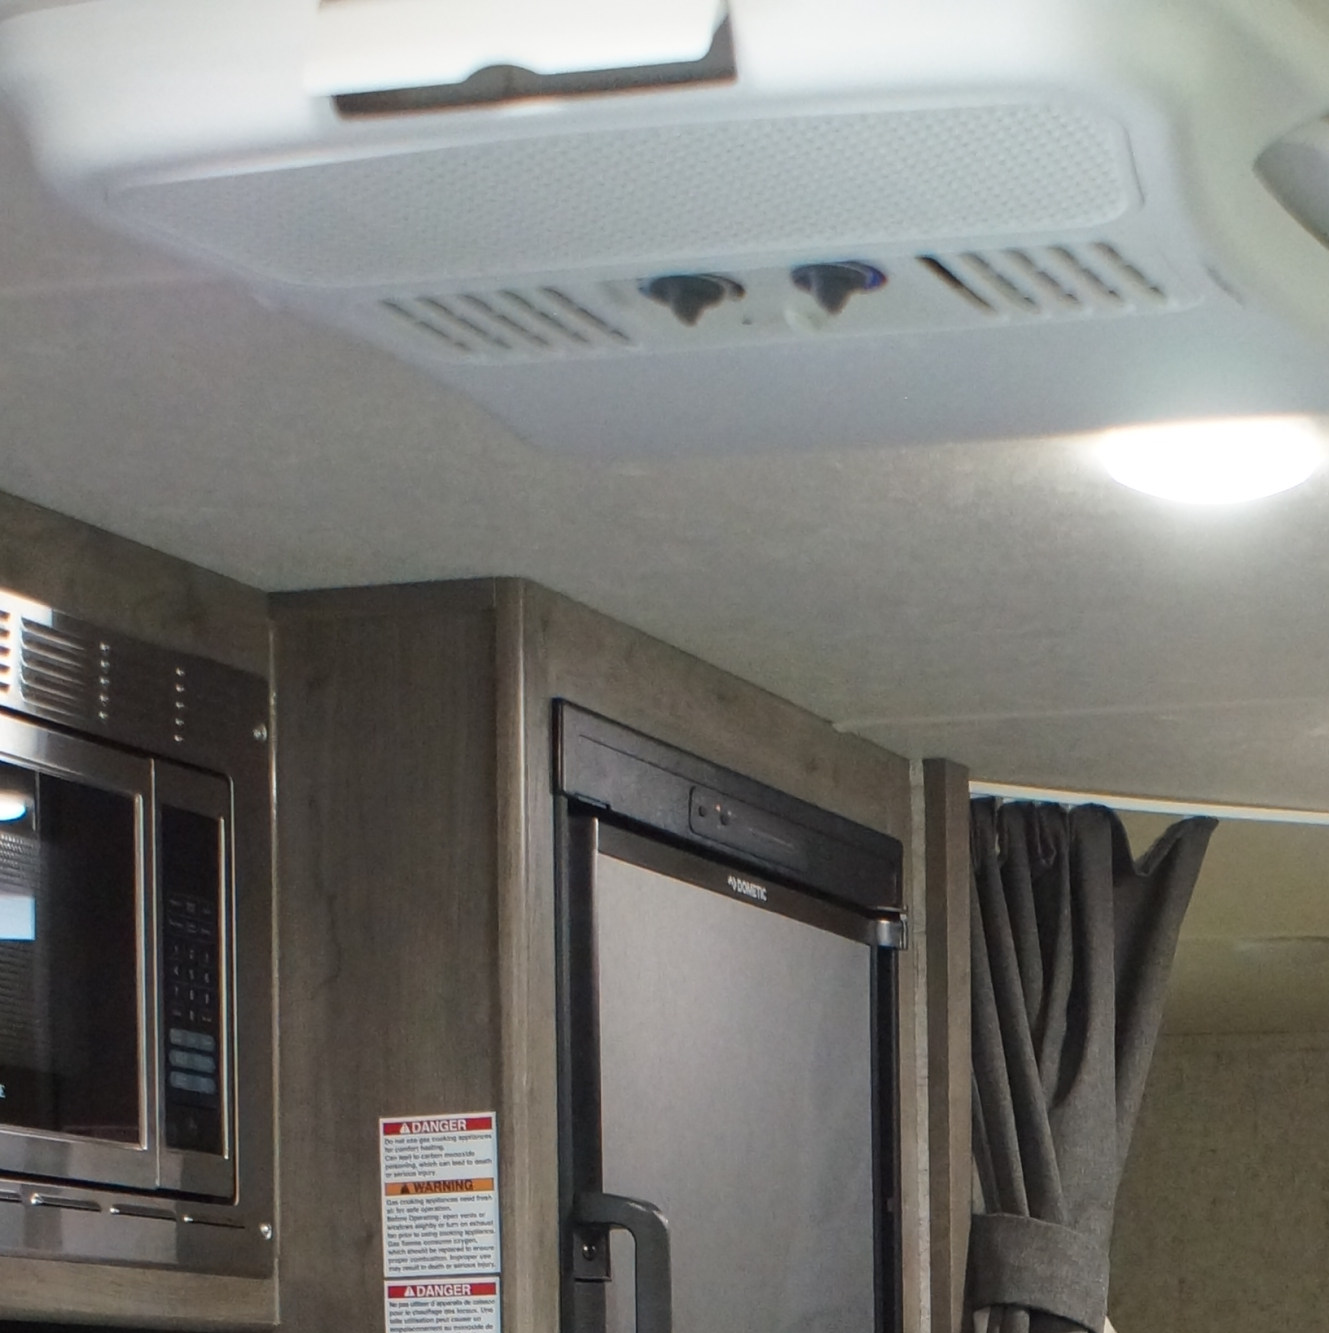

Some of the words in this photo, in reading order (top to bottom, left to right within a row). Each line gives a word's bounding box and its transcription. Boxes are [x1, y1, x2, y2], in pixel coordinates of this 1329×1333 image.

[737, 878, 767, 901] DOMETIC
[413, 1120, 466, 1133] DANGER
[415, 1180, 473, 1192] WARNING
[417, 1284, 471, 1297] DANGER
